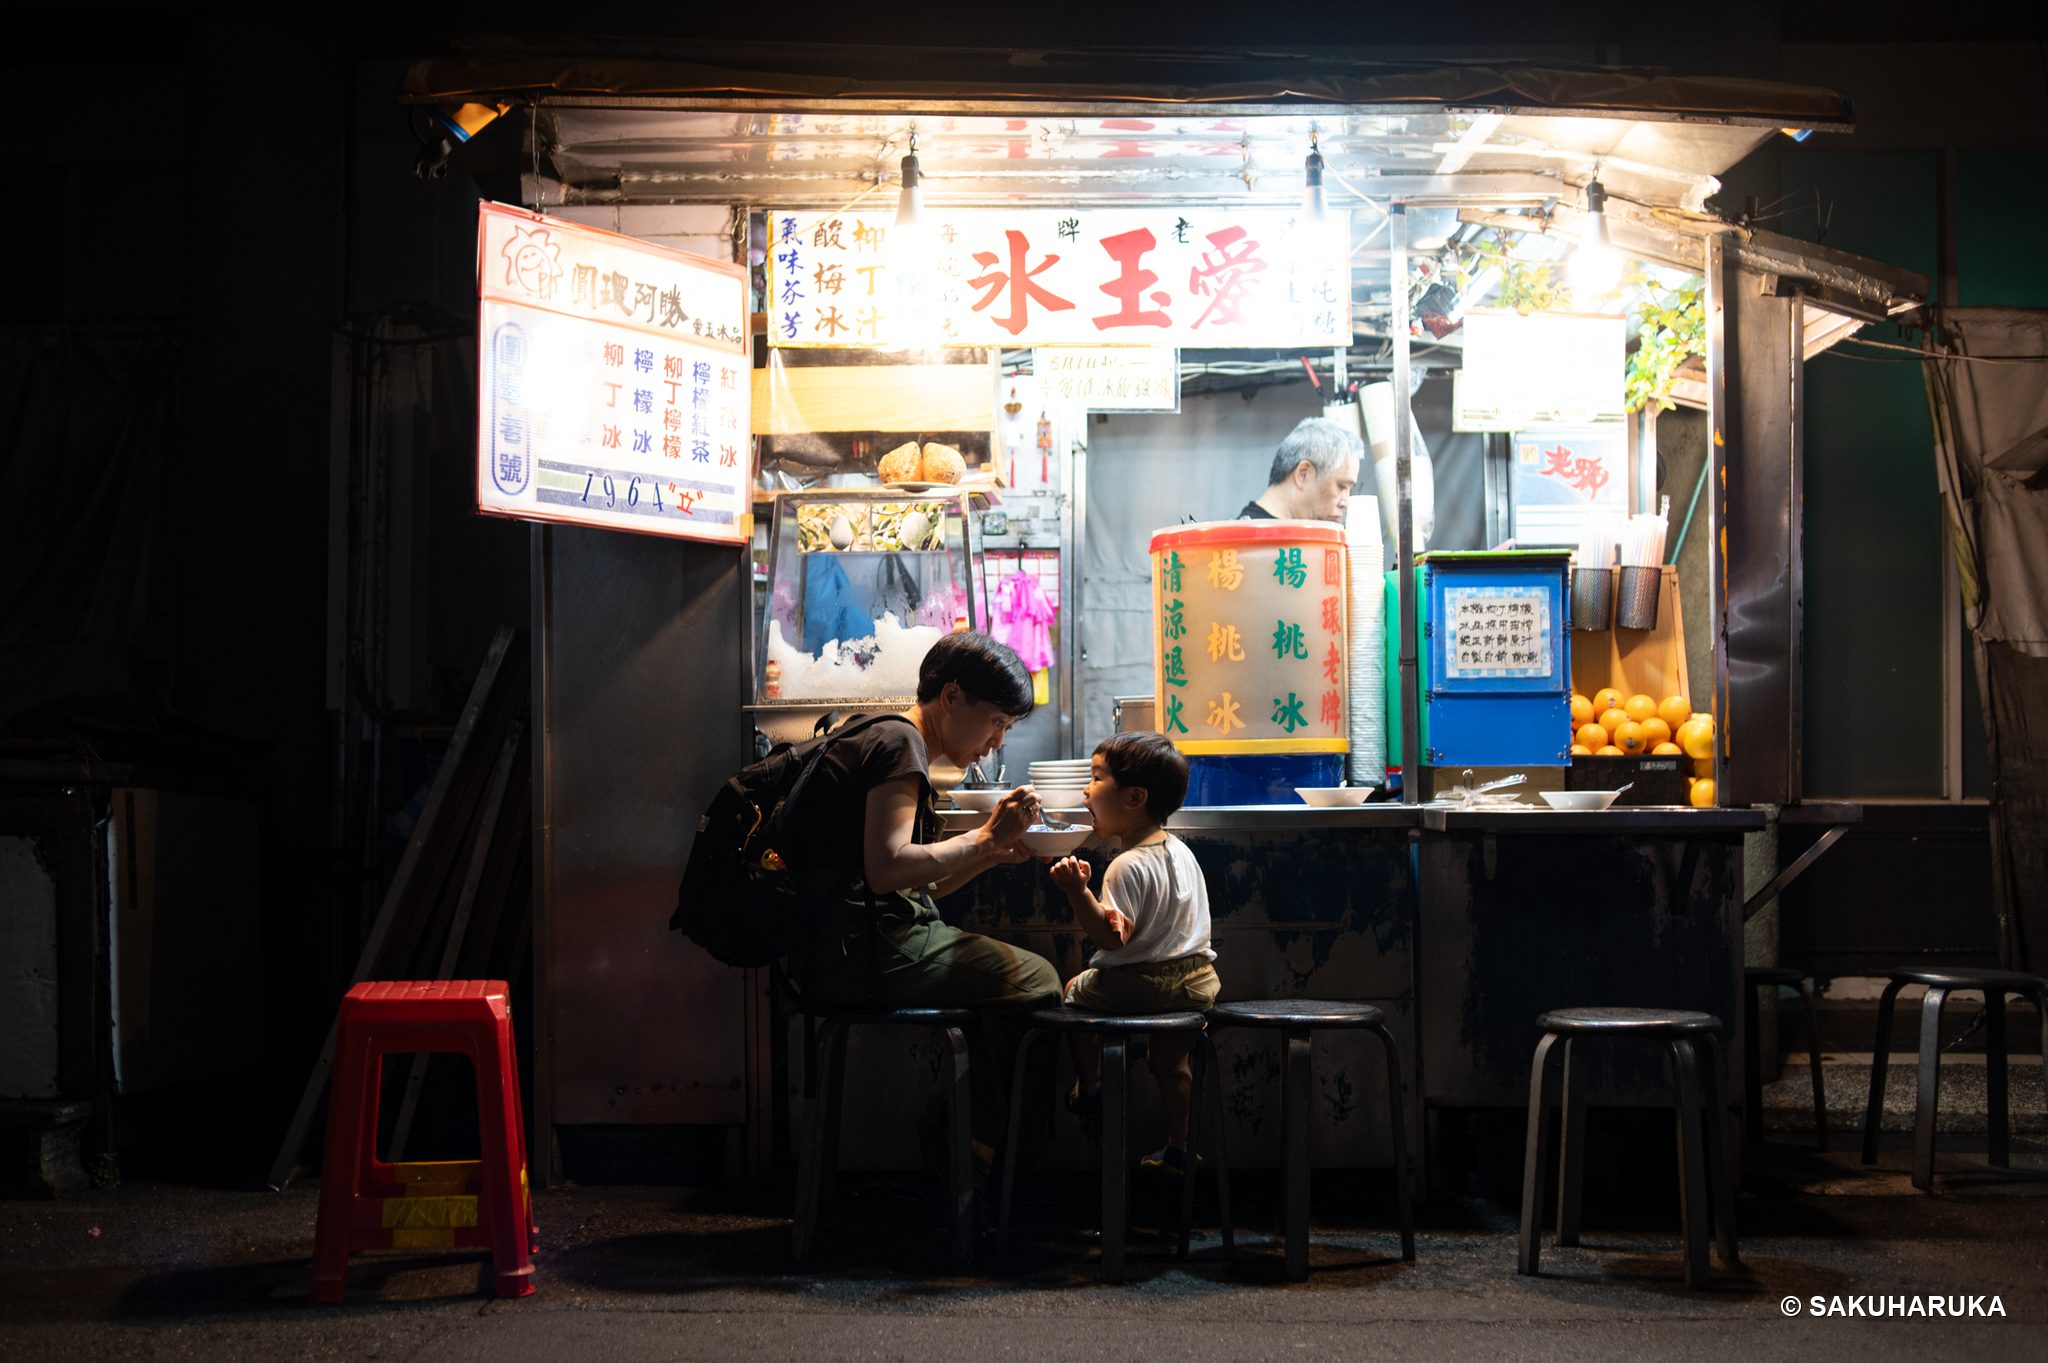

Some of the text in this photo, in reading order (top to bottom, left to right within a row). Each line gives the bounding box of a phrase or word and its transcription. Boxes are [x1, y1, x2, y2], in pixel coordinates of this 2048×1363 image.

[778, 216, 806, 339] 氣味芬芳
[813, 220, 849, 338] 酸梅冰
[853, 219, 888, 338] 柳丁汁
[602, 341, 624, 449] 柳丁冰
[633, 348, 653, 454] 檸檬冰
[662, 354, 683, 460] 柳丁檸檬
[691, 361, 711, 463] 檸檬紅茶
[579, 472, 665, 512] 1964
[1206, 549, 1246, 736] 楊桃冰
[1271, 548, 1309, 734] 楊桃冰
[1320, 549, 1342, 735] 圓環老牌
